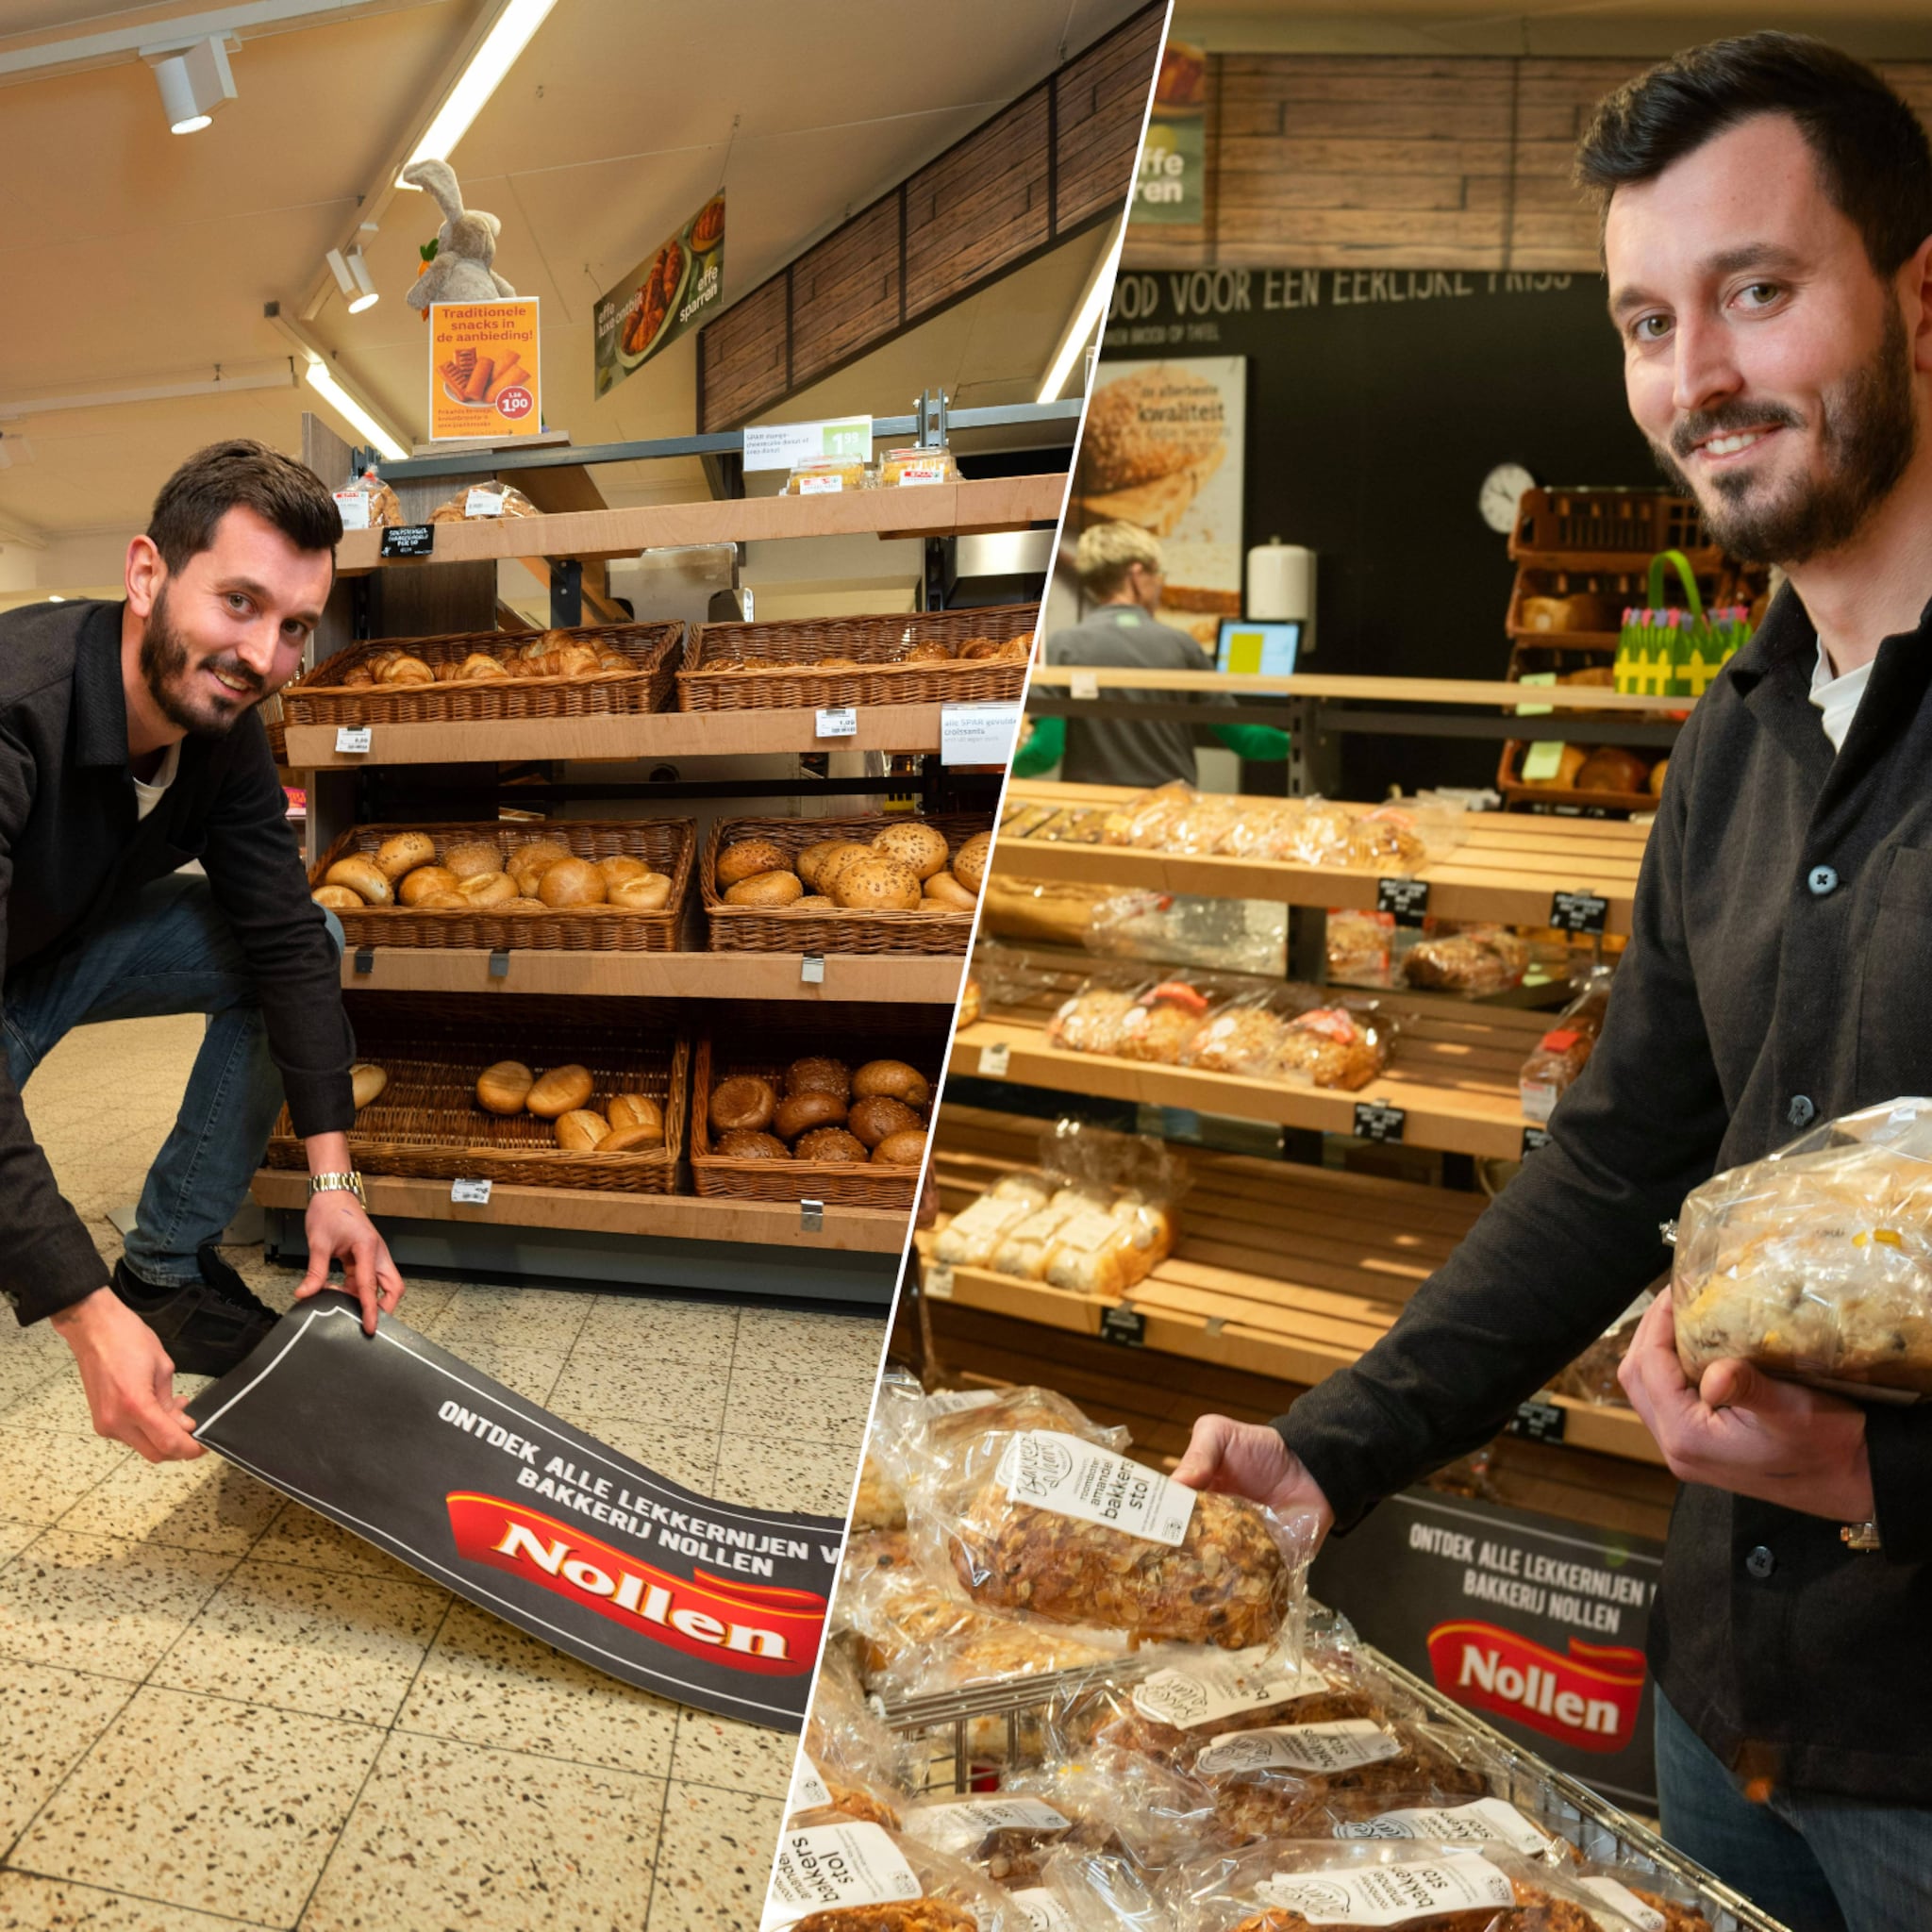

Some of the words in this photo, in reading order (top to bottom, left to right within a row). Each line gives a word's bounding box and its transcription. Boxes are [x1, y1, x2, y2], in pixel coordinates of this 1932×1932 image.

[698, 265, 718, 291] effe
[1170, 270, 1251, 315] VOOR
[1264, 270, 1320, 309] EEN
[442, 307, 526, 319] Traditionele
[451, 320, 498, 330] snacks
[503, 319, 515, 328] in
[599, 303, 615, 324] effe
[679, 283, 718, 323] sparren
[437, 332, 453, 342] de
[457, 330, 533, 342] aanbieding!
[1138, 402, 1224, 423] kwaliteit
[438, 1400, 541, 1465] ONTDEK
[544, 1456, 613, 1500] ALLE
[618, 1489, 808, 1560] LEKKERNIJEN
[1091, 1458, 1113, 1506] amandel
[1099, 1459, 1134, 1520] bakkers
[1129, 1476, 1150, 1509] stol
[516, 1467, 653, 1539] BAKKERIJ
[658, 1528, 774, 1577] NOLLEN
[1409, 1523, 1474, 1562] ONTDEK
[1477, 1541, 1522, 1575] ALLE
[1524, 1553, 1645, 1607] LEKKERNIJEN
[491, 1521, 792, 1660] Nollen
[1464, 1570, 1547, 1615] BAKKERIJ
[1549, 1592, 1621, 1634] NOLLEN
[1458, 1645, 1621, 1735] Nollen
[792, 1837, 841, 1903] bakkers
[819, 1851, 854, 1883] stol
